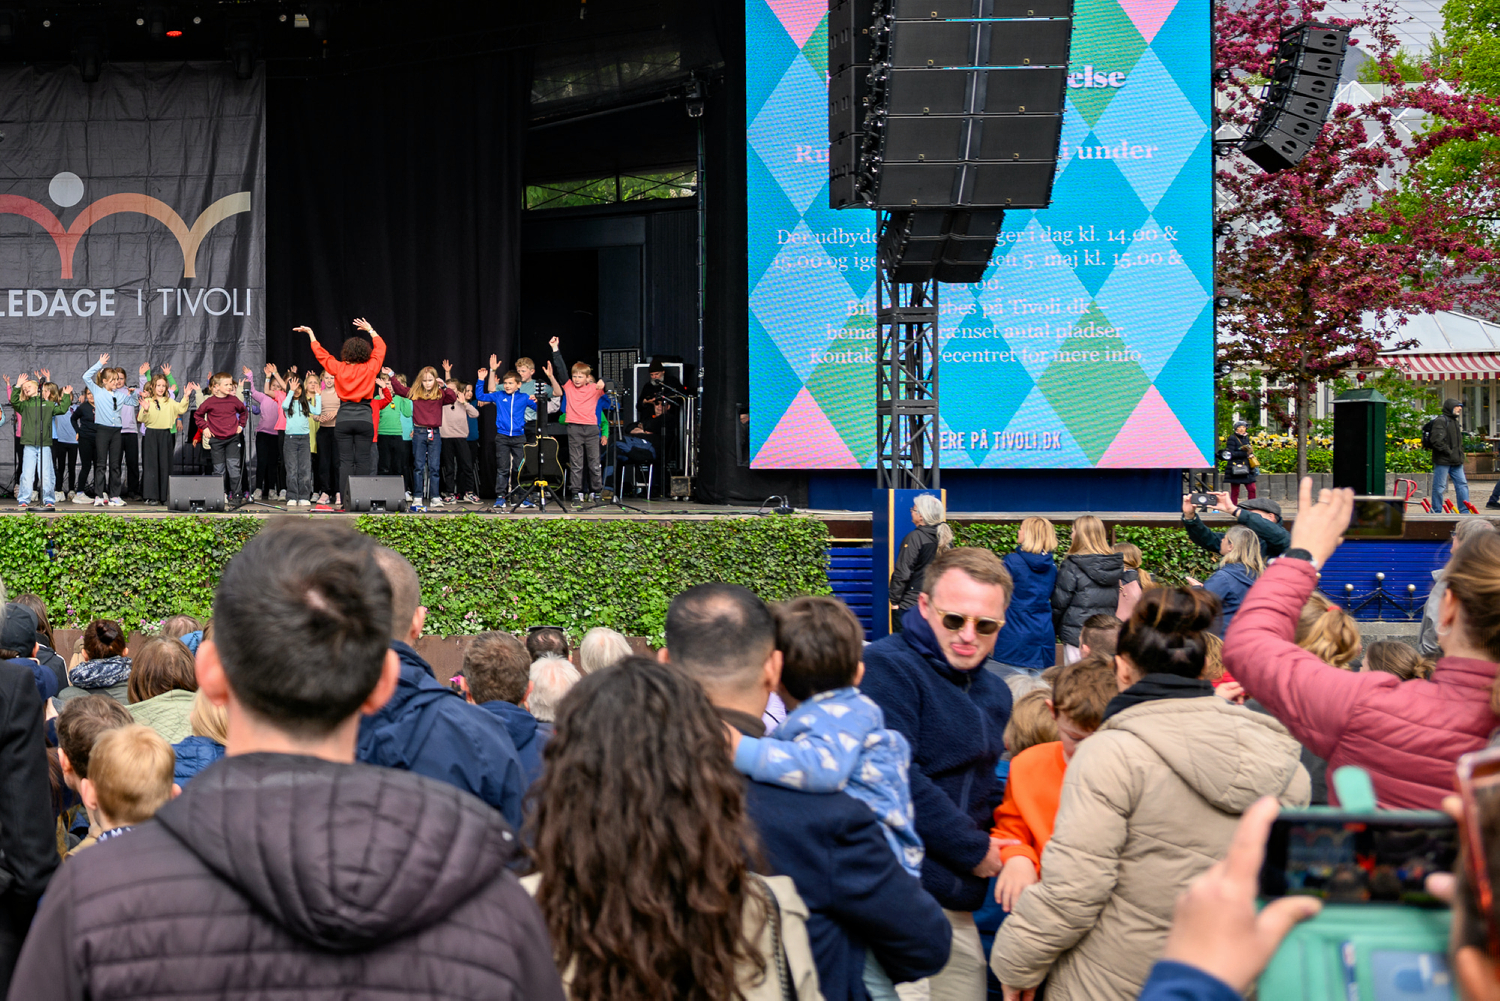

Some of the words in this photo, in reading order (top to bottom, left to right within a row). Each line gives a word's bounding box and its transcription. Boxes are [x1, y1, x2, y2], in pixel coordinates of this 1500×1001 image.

[1076, 139, 1159, 160] under
[777, 229, 811, 245] Der
[1041, 226, 1074, 246] dag
[1079, 225, 1100, 241] kl.
[1107, 229, 1158, 245] 14.00
[1164, 225, 1179, 241] &
[827, 256, 848, 272] og
[1045, 250, 1078, 270] maj
[1084, 249, 1106, 266] kl.
[1112, 253, 1163, 269] 15.00
[1168, 249, 1183, 265] &
[156, 288, 252, 317] TIVOLI
[1004, 322, 1050, 339] antal
[810, 347, 877, 363] Kontak
[1054, 349, 1101, 363] mere
[971, 428, 989, 450] PÅ
